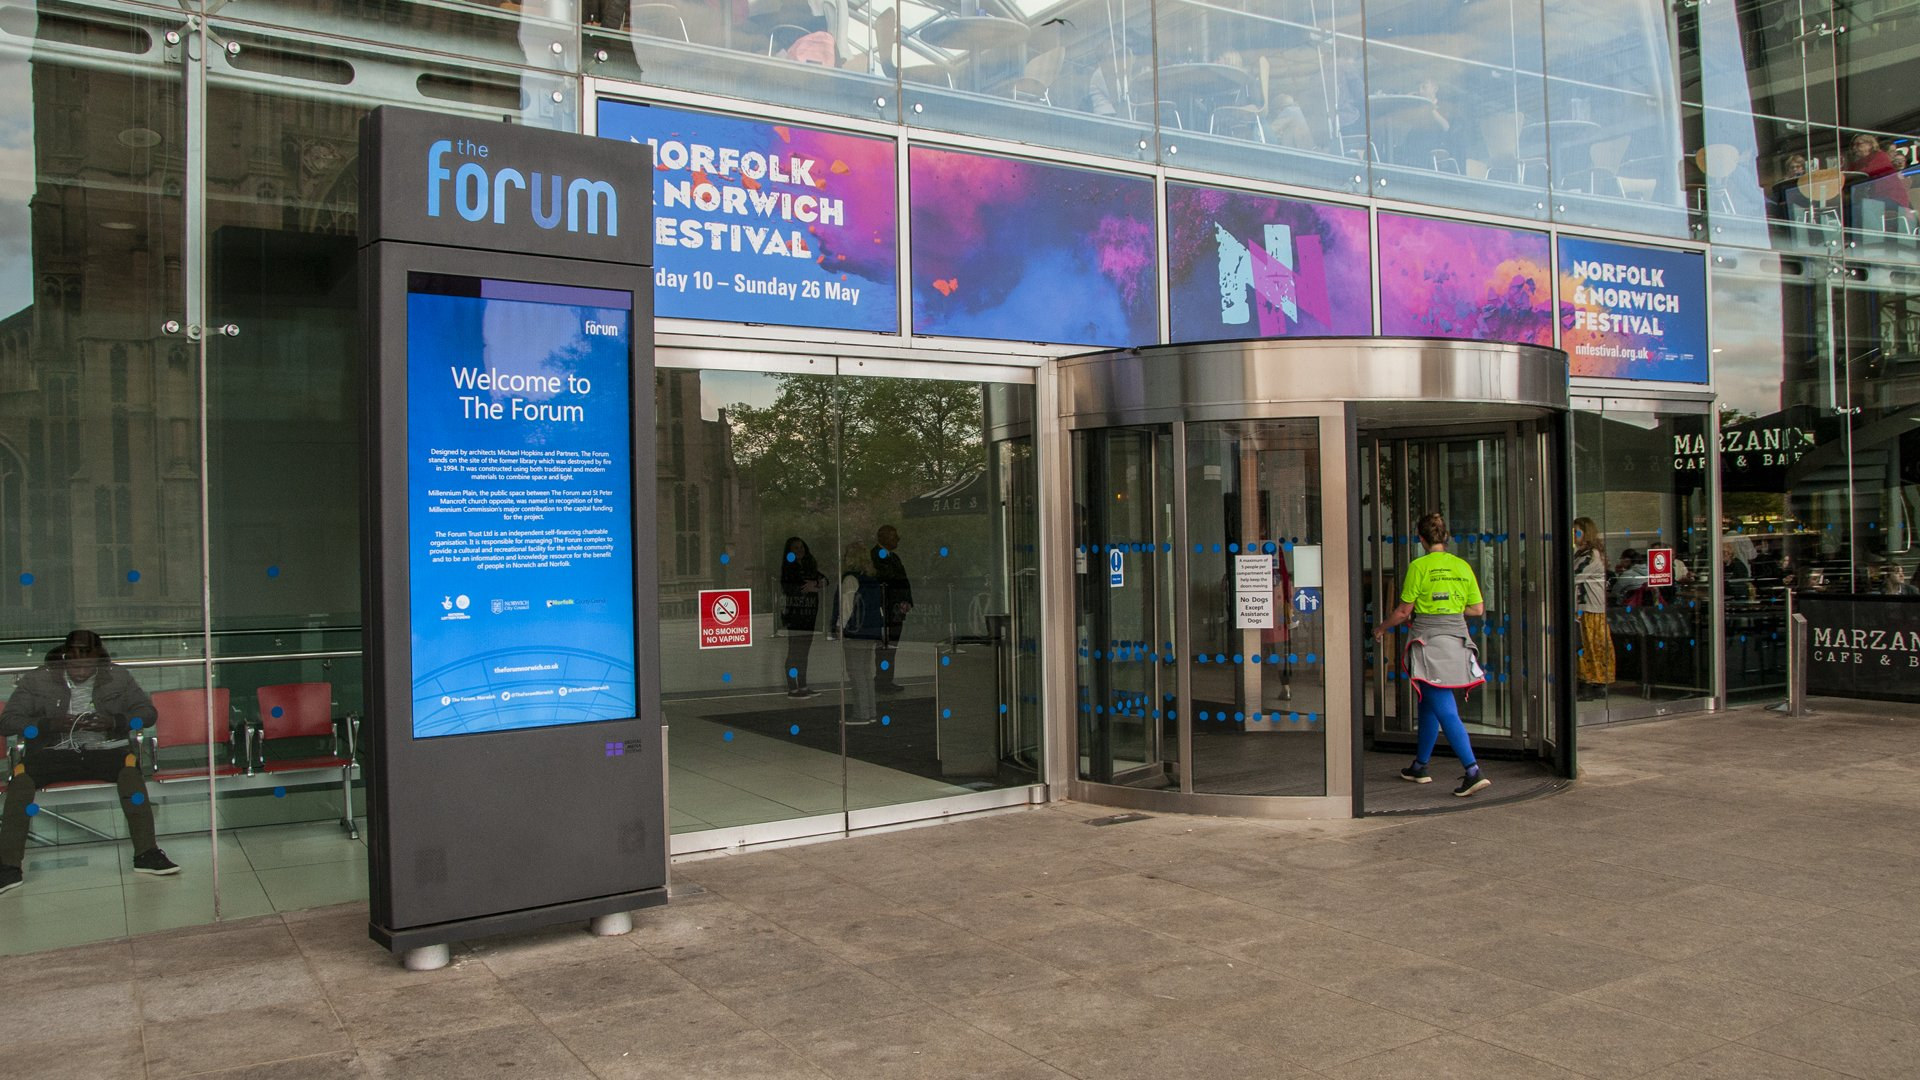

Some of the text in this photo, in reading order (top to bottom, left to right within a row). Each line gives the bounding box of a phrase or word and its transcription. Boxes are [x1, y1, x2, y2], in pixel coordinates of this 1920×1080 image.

[457, 138, 488, 158] the
[428, 140, 617, 236] forum
[663, 179, 844, 226] NORWICH
[656, 216, 812, 259] ESTIVAL
[1574, 260, 1664, 288] NORFOLK
[693, 271, 712, 290] 10
[734, 274, 797, 301] Sunday
[802, 280, 820, 299] 26
[825, 282, 859, 306] May
[1574, 286, 1679, 313] & NORWICH
[1575, 310, 1664, 336] FESTIVAL
[1576, 343, 1648, 361] nnfestival.org.uk
[451, 366, 591, 394] Welcome to
[459, 396, 584, 422] The Forum
[430, 449, 458, 457] Designed
[567, 458, 593, 466] destroyed
[1674, 457, 1706, 469] CAF
[1736, 455, 1747, 467] &
[430, 539, 468, 547] organisation.
[481, 538, 513, 546] responsible
[583, 536, 605, 544] complex
[508, 529, 543, 538] independent
[545, 529, 580, 537] self-financing
[716, 627, 748, 635] SMOKING
[1814, 650, 1862, 664] CAFE
[1880, 654, 1890, 665] &
